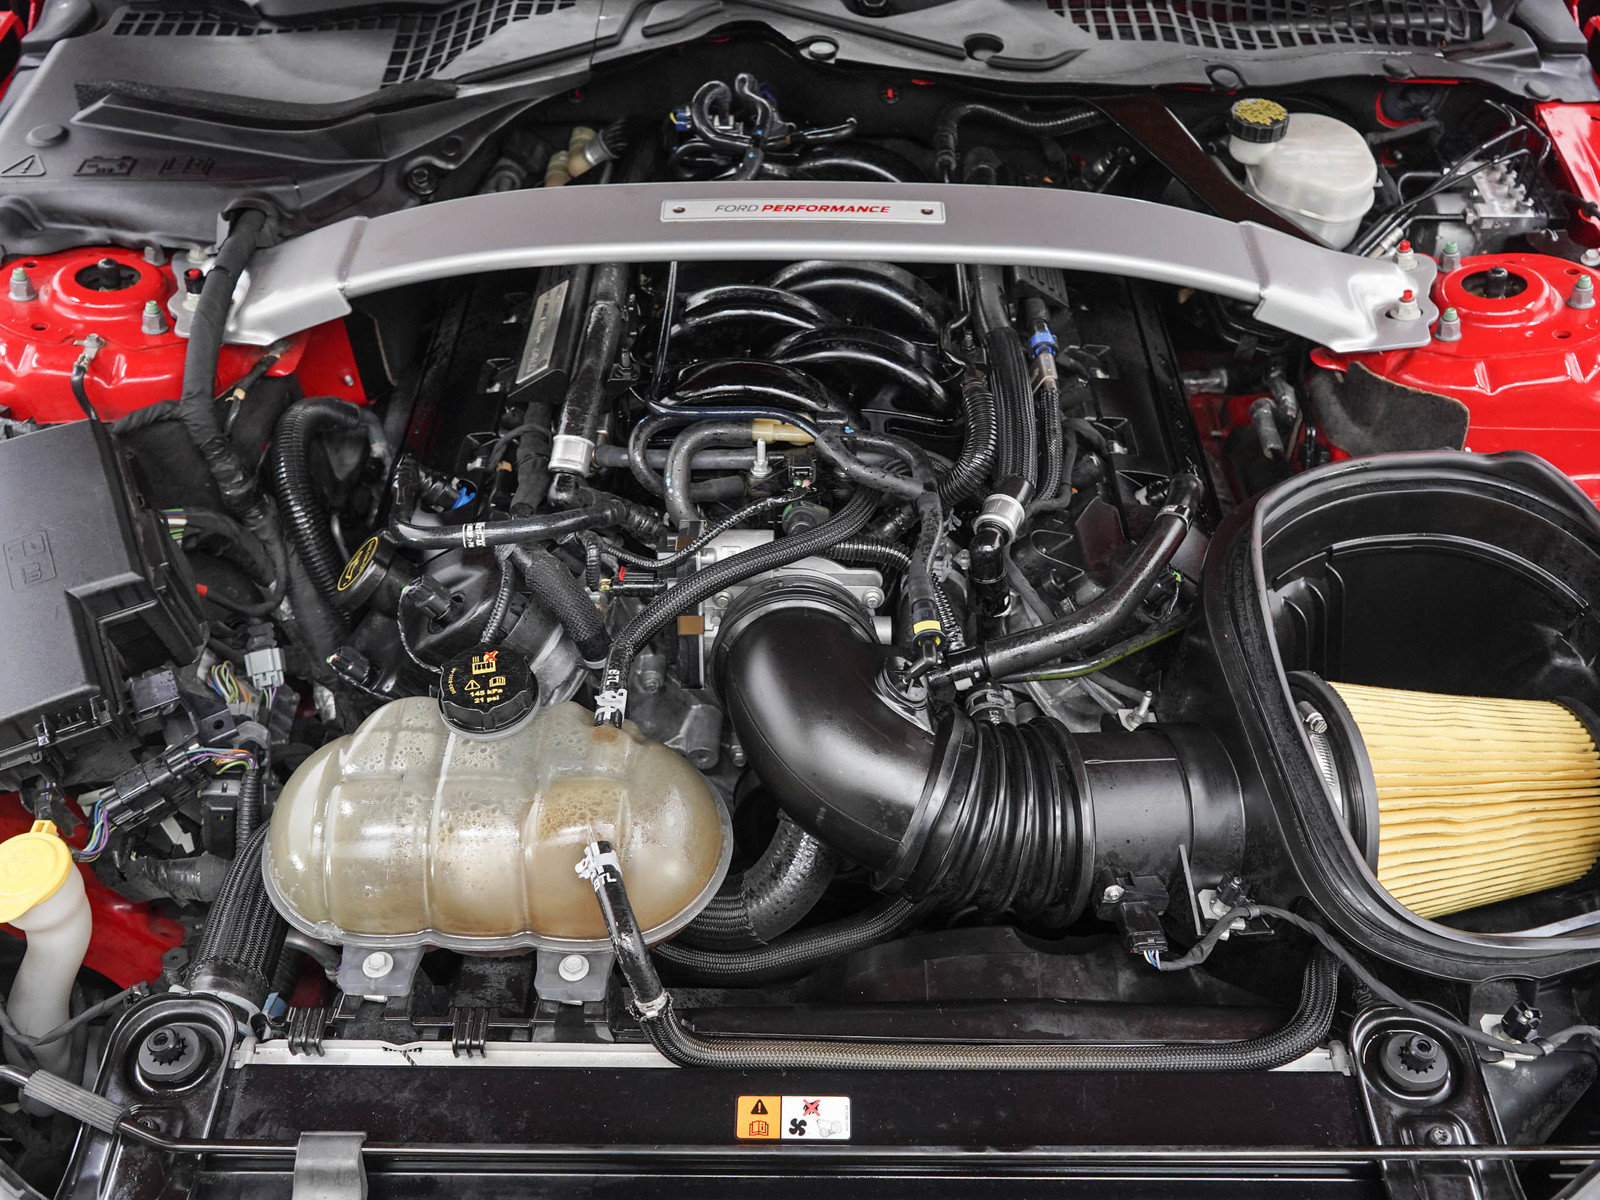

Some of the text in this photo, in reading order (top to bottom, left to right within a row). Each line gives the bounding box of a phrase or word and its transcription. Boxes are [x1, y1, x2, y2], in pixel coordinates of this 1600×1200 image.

[714, 204, 891, 214] FORD PERFORMANCE
[469, 690, 485, 698] 145
[473, 695, 500, 704] 21 psi
